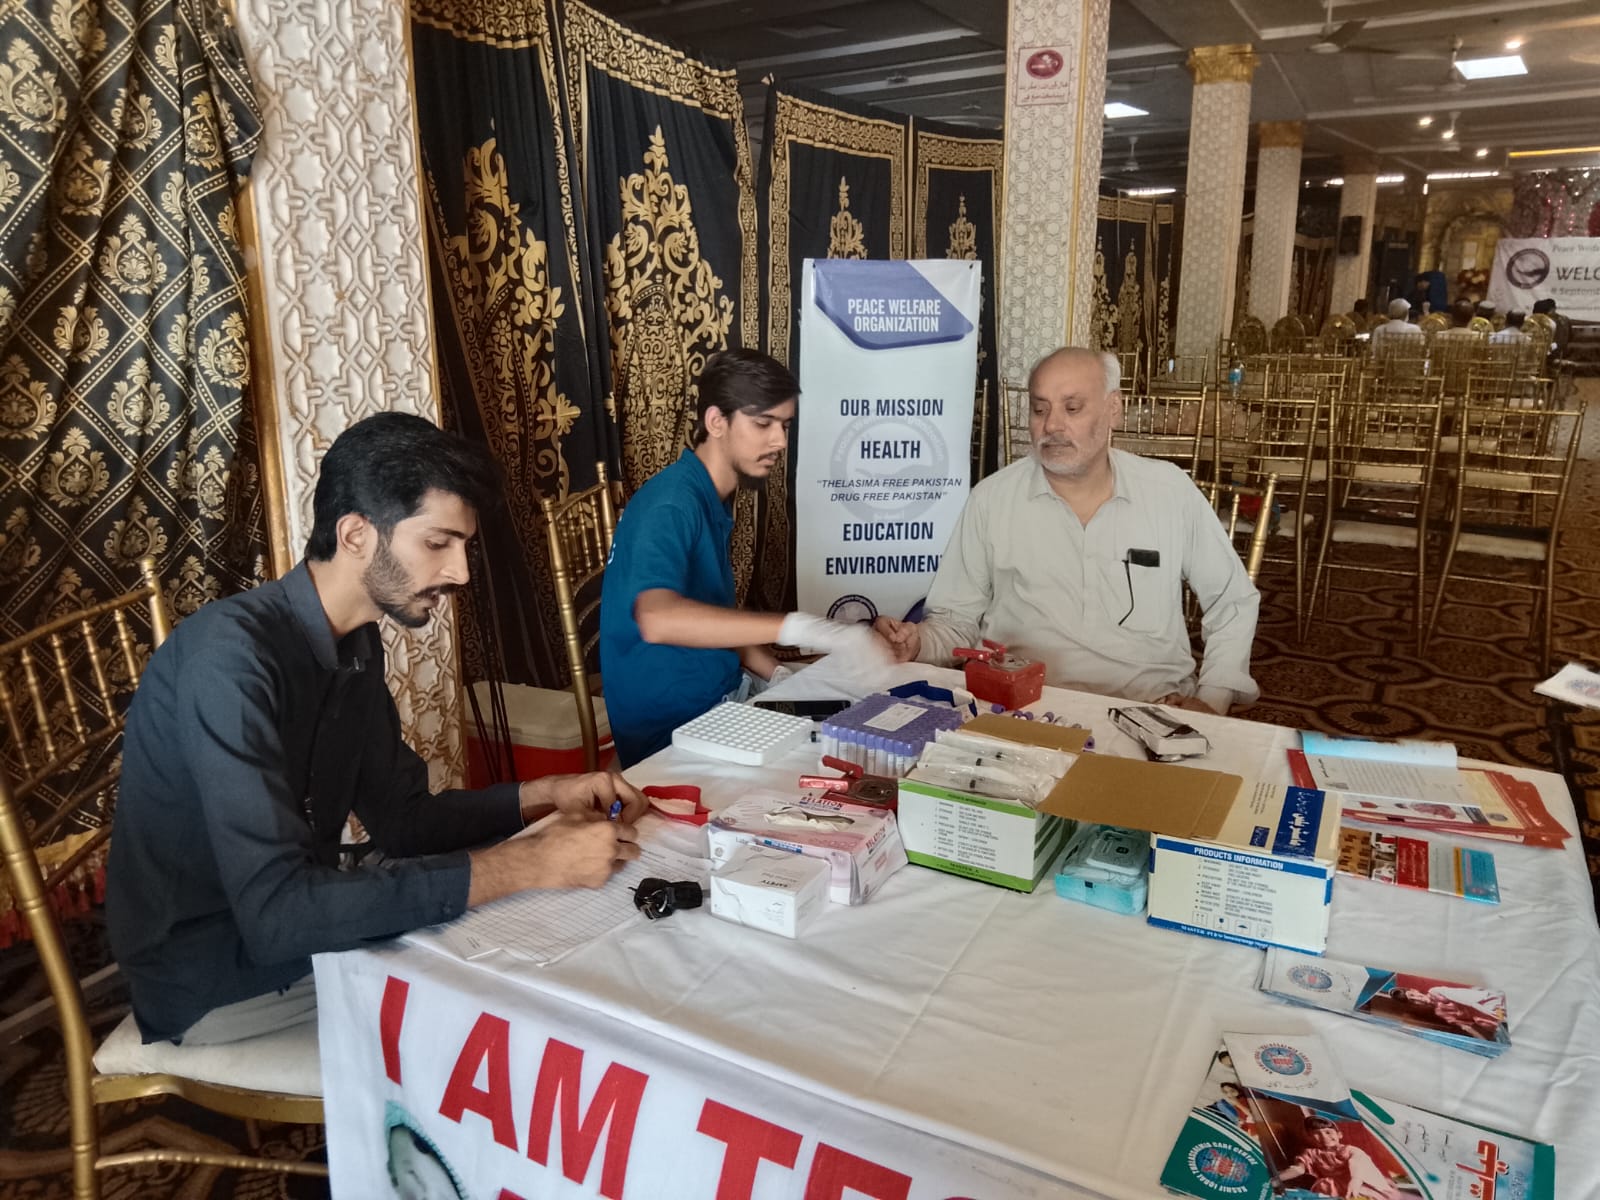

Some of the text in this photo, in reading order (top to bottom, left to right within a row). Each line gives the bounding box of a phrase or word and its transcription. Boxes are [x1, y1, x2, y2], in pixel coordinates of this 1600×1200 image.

[848, 299, 941, 315] PEACE WELFARE
[854, 316, 939, 332] ORGANIZATION
[840, 399, 943, 416] OUR MISSION
[861, 440, 921, 459] HEALTH
[882, 479, 909, 487] FREE
[911, 478, 962, 487] PAKISTAN
[830, 493, 862, 502] DRUG
[863, 492, 890, 501] FREE
[843, 522, 934, 541] EDUCATION
[826, 555, 943, 575] ENVIRONMEN
[1194, 846, 1284, 870] PRODUCTS INFORMATION
[380, 975, 410, 1087] I
[438, 1011, 650, 1200] AM
